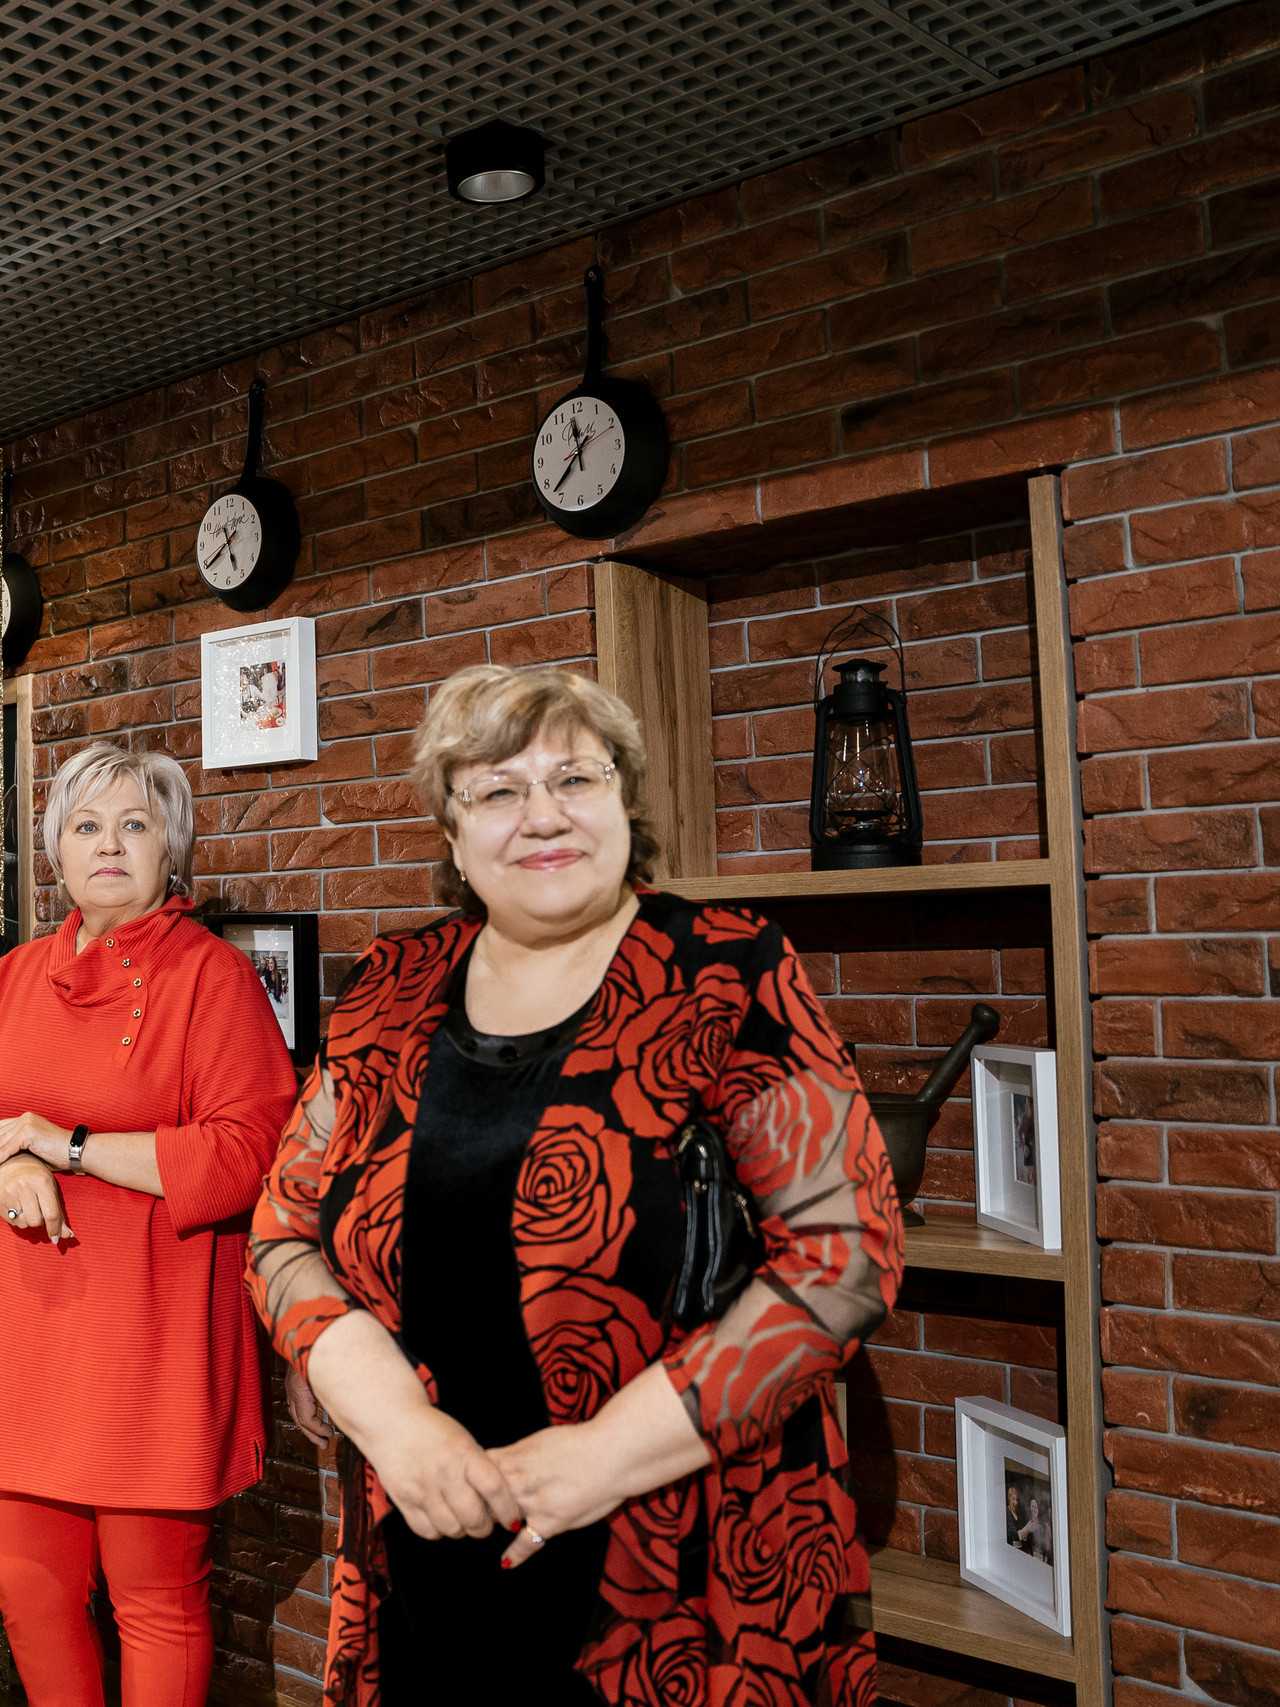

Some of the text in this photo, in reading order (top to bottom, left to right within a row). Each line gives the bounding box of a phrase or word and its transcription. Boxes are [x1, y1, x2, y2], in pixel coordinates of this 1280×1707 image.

[572, 401, 583, 414] 12
[594, 404, 599, 414] 1
[555, 413, 564, 425] 11
[608, 418, 614, 429] 2
[541, 433, 552, 445] 10
[615, 439, 621, 450] 3
[538, 458, 543, 468] 9
[610, 464, 616, 474] 4
[544, 479, 550, 489] 8
[597, 484, 603, 495] 5
[226, 498, 234, 508] 12
[558, 493, 564, 503] 7
[577, 495, 583, 505] 6
[214, 506, 221, 516] 11
[241, 501, 245, 511] 1
[251, 514, 256, 524] 2
[203, 522, 211, 532] 10
[254, 533, 259, 542] 3
[200, 542, 204, 551] 9
[250, 553, 254, 562] 4
[213, 573, 217, 582] 7
[240, 569, 244, 578] 5
[226, 576, 231, 585] 6
